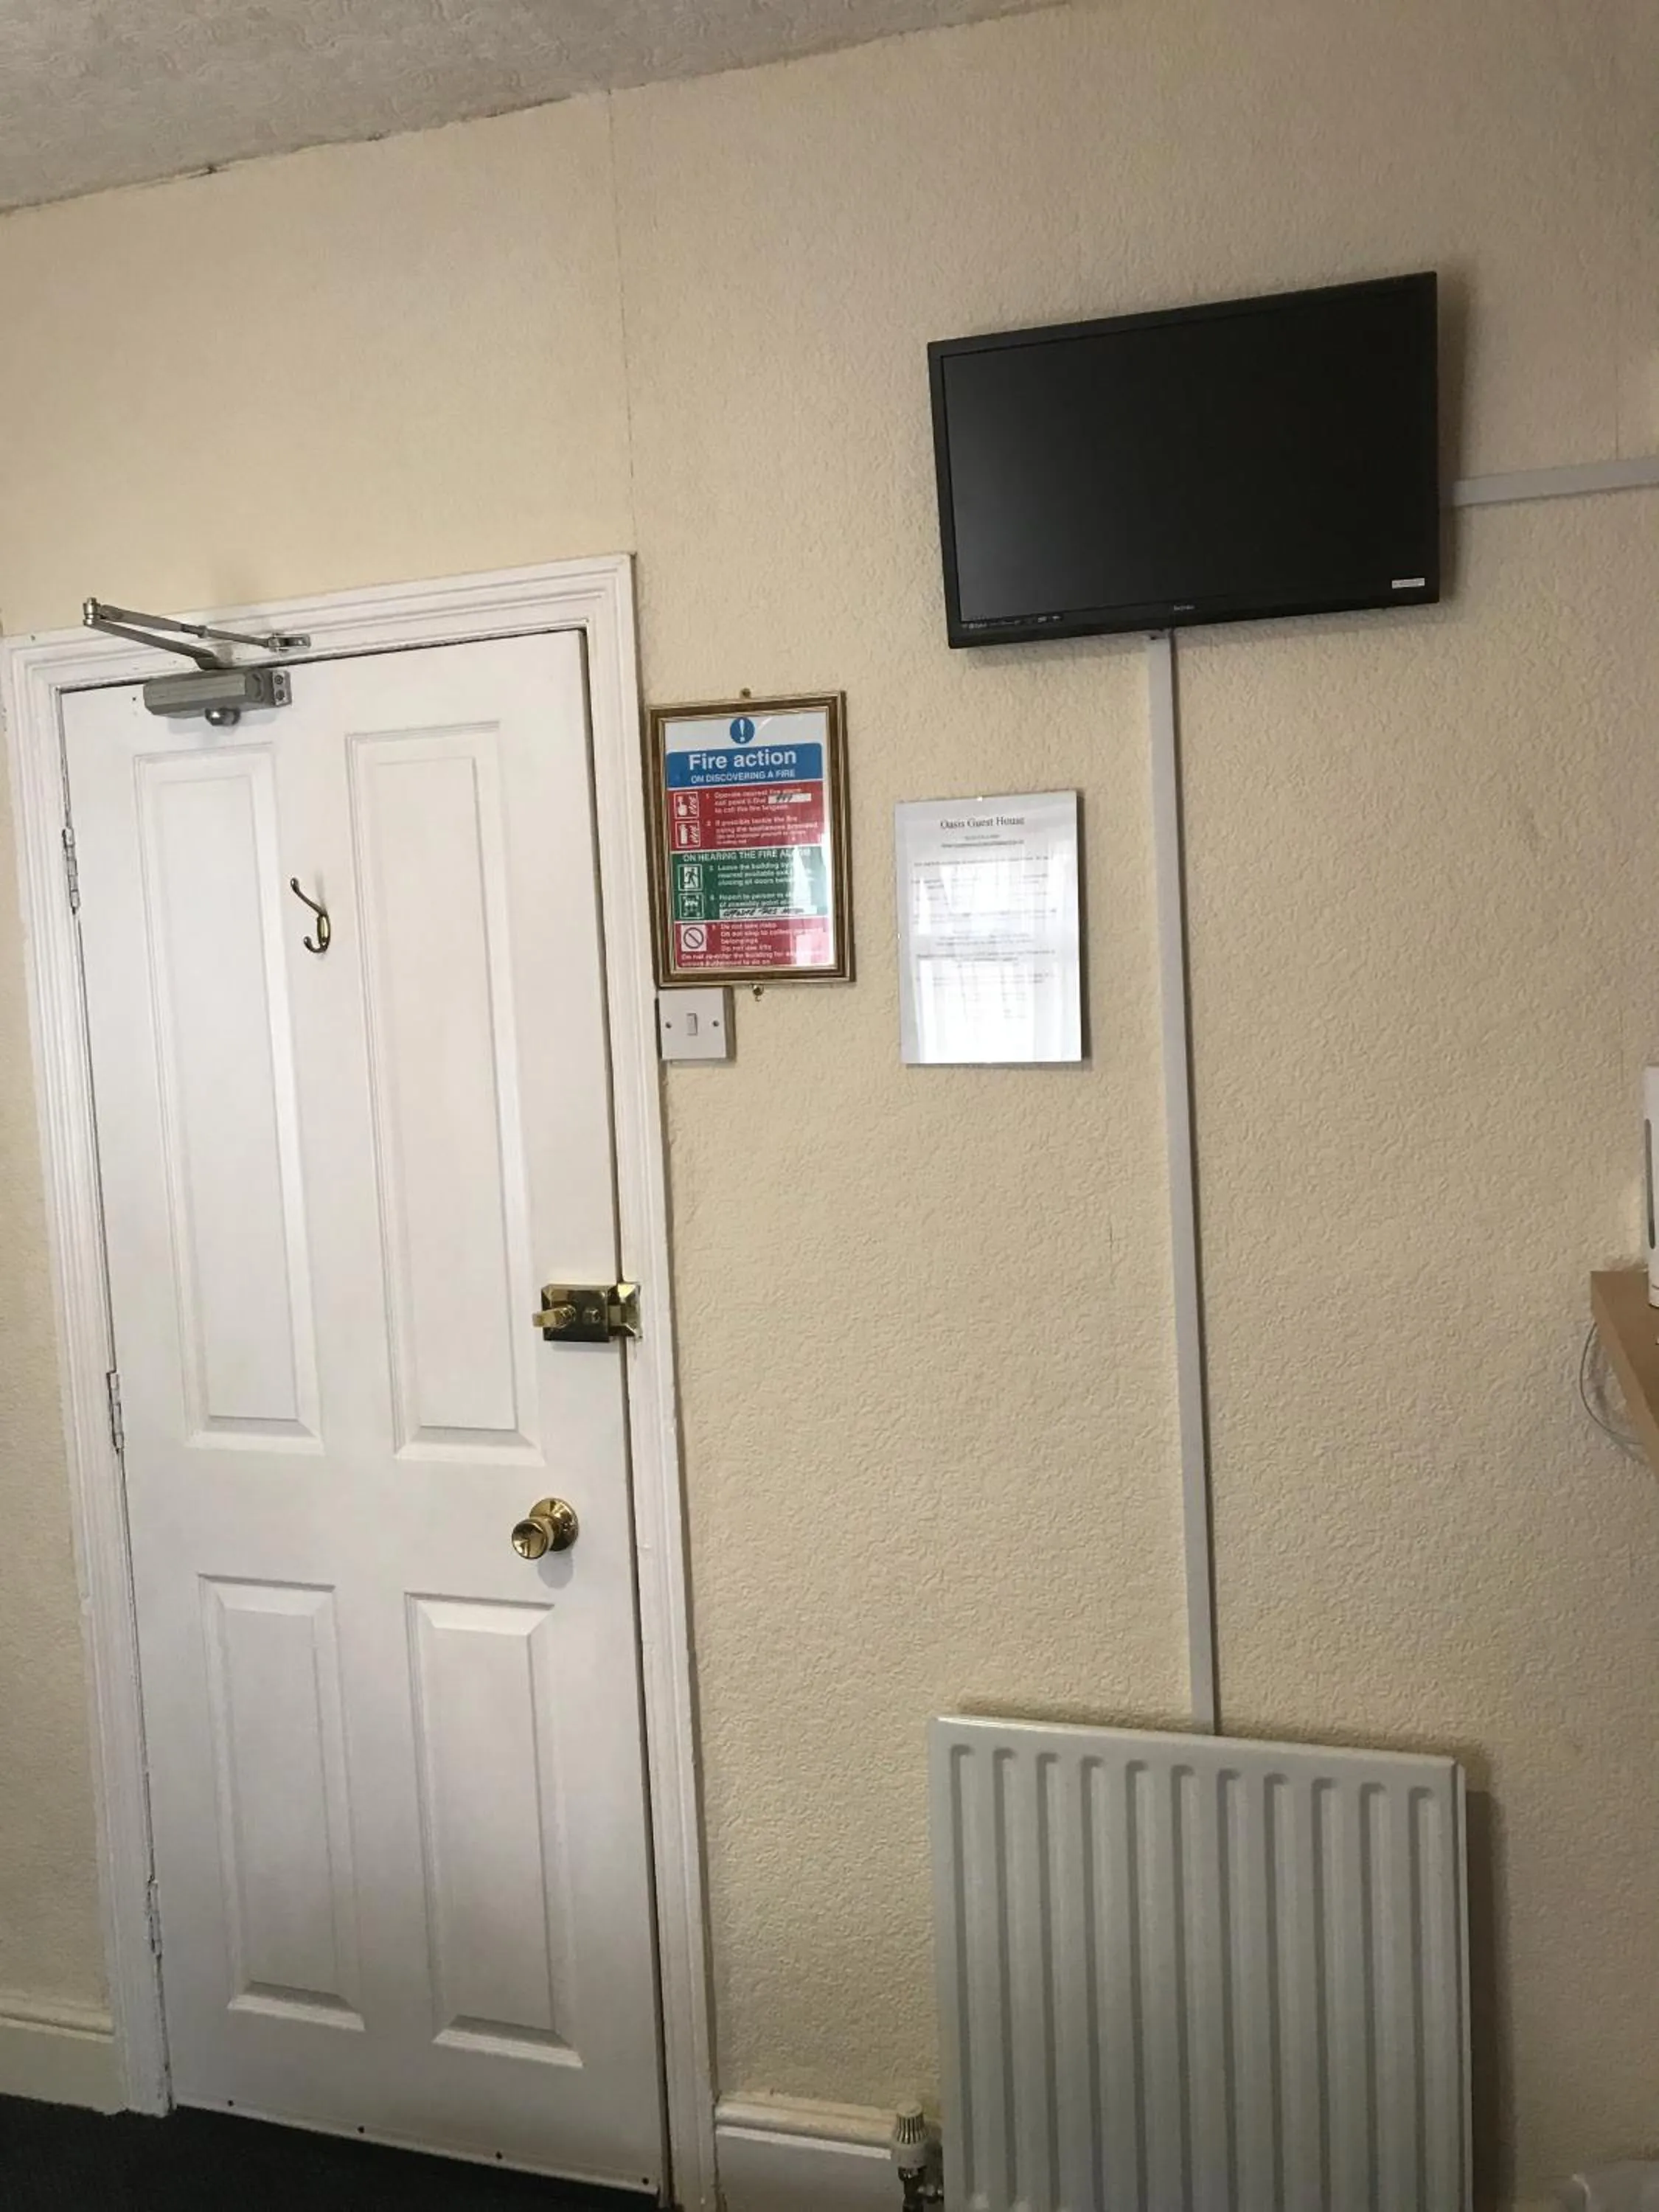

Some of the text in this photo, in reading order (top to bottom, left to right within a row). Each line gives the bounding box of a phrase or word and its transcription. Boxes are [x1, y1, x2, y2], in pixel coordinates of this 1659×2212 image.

[689, 749, 796, 770] Fire action
[691, 775, 703, 784] ON
[706, 771, 765, 782] DISCOVERING
[776, 769, 795, 778] FIRE
[940, 815, 1025, 829] Oasis Guest House
[683, 853, 697, 862] ON
[699, 852, 737, 861] HEARING
[740, 851, 756, 860] THE
[758, 849, 778, 859] FIRE
